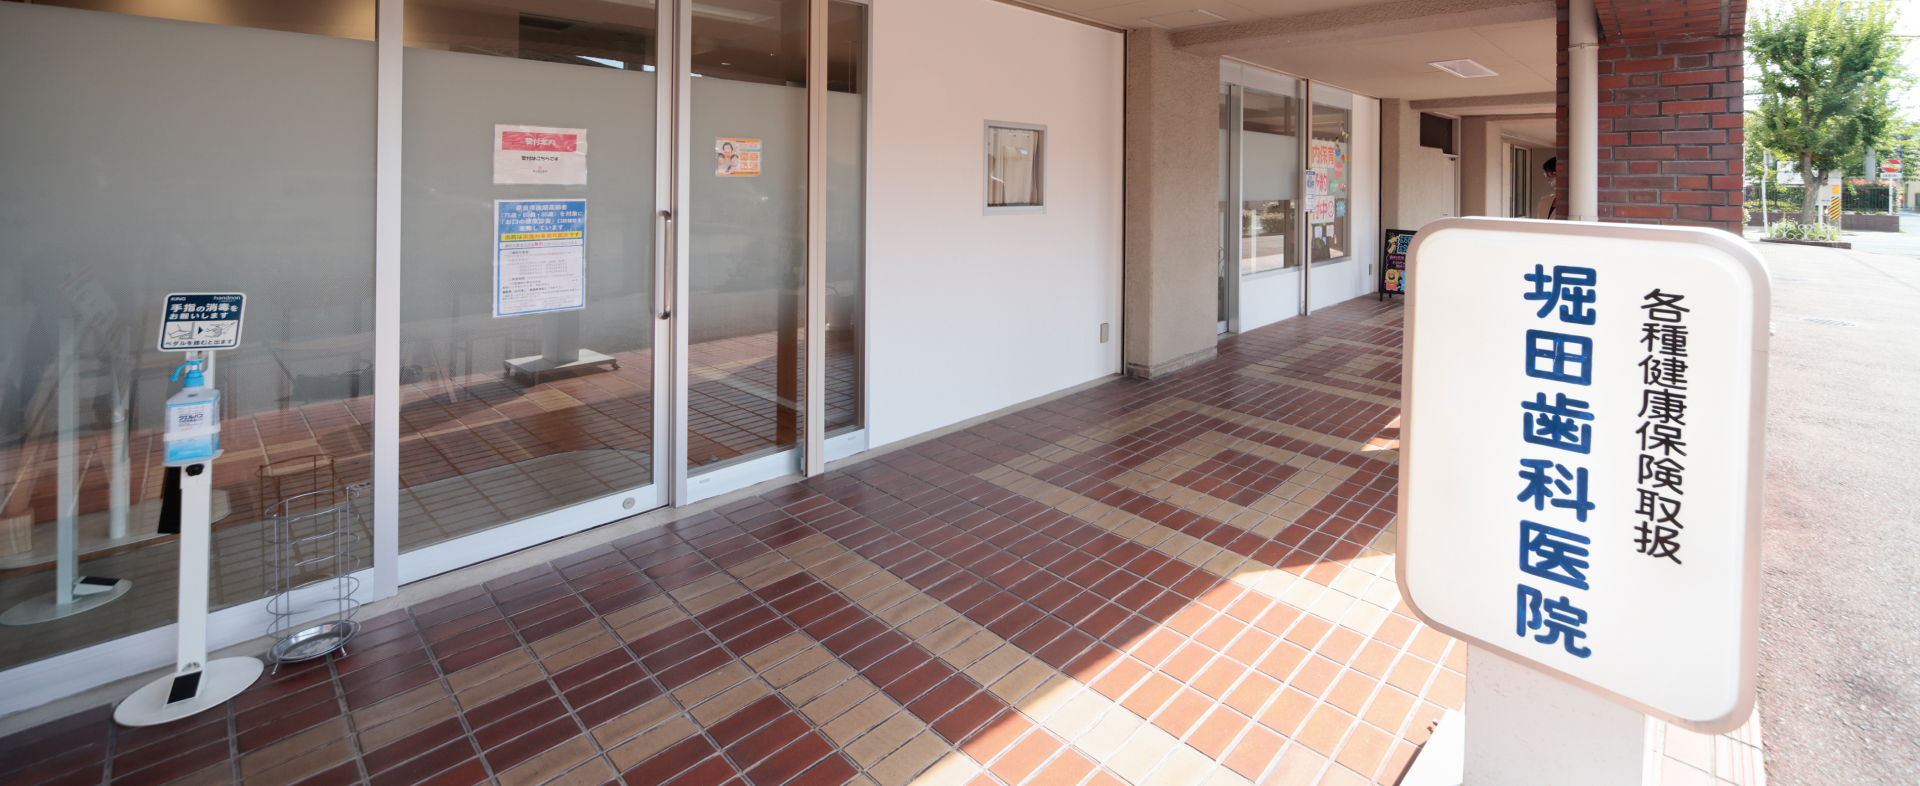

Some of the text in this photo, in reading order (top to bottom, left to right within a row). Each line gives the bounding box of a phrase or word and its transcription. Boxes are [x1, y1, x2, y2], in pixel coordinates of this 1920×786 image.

[525, 137, 556, 146] 受付案内
[1312, 146, 1335, 165] 内保育
[169, 303, 239, 313] 手指の消毒を
[168, 312, 229, 320] お願いします
[1633, 288, 1691, 566] 各種健康保険取扱
[1516, 263, 1597, 659] 堀田歯科医院
